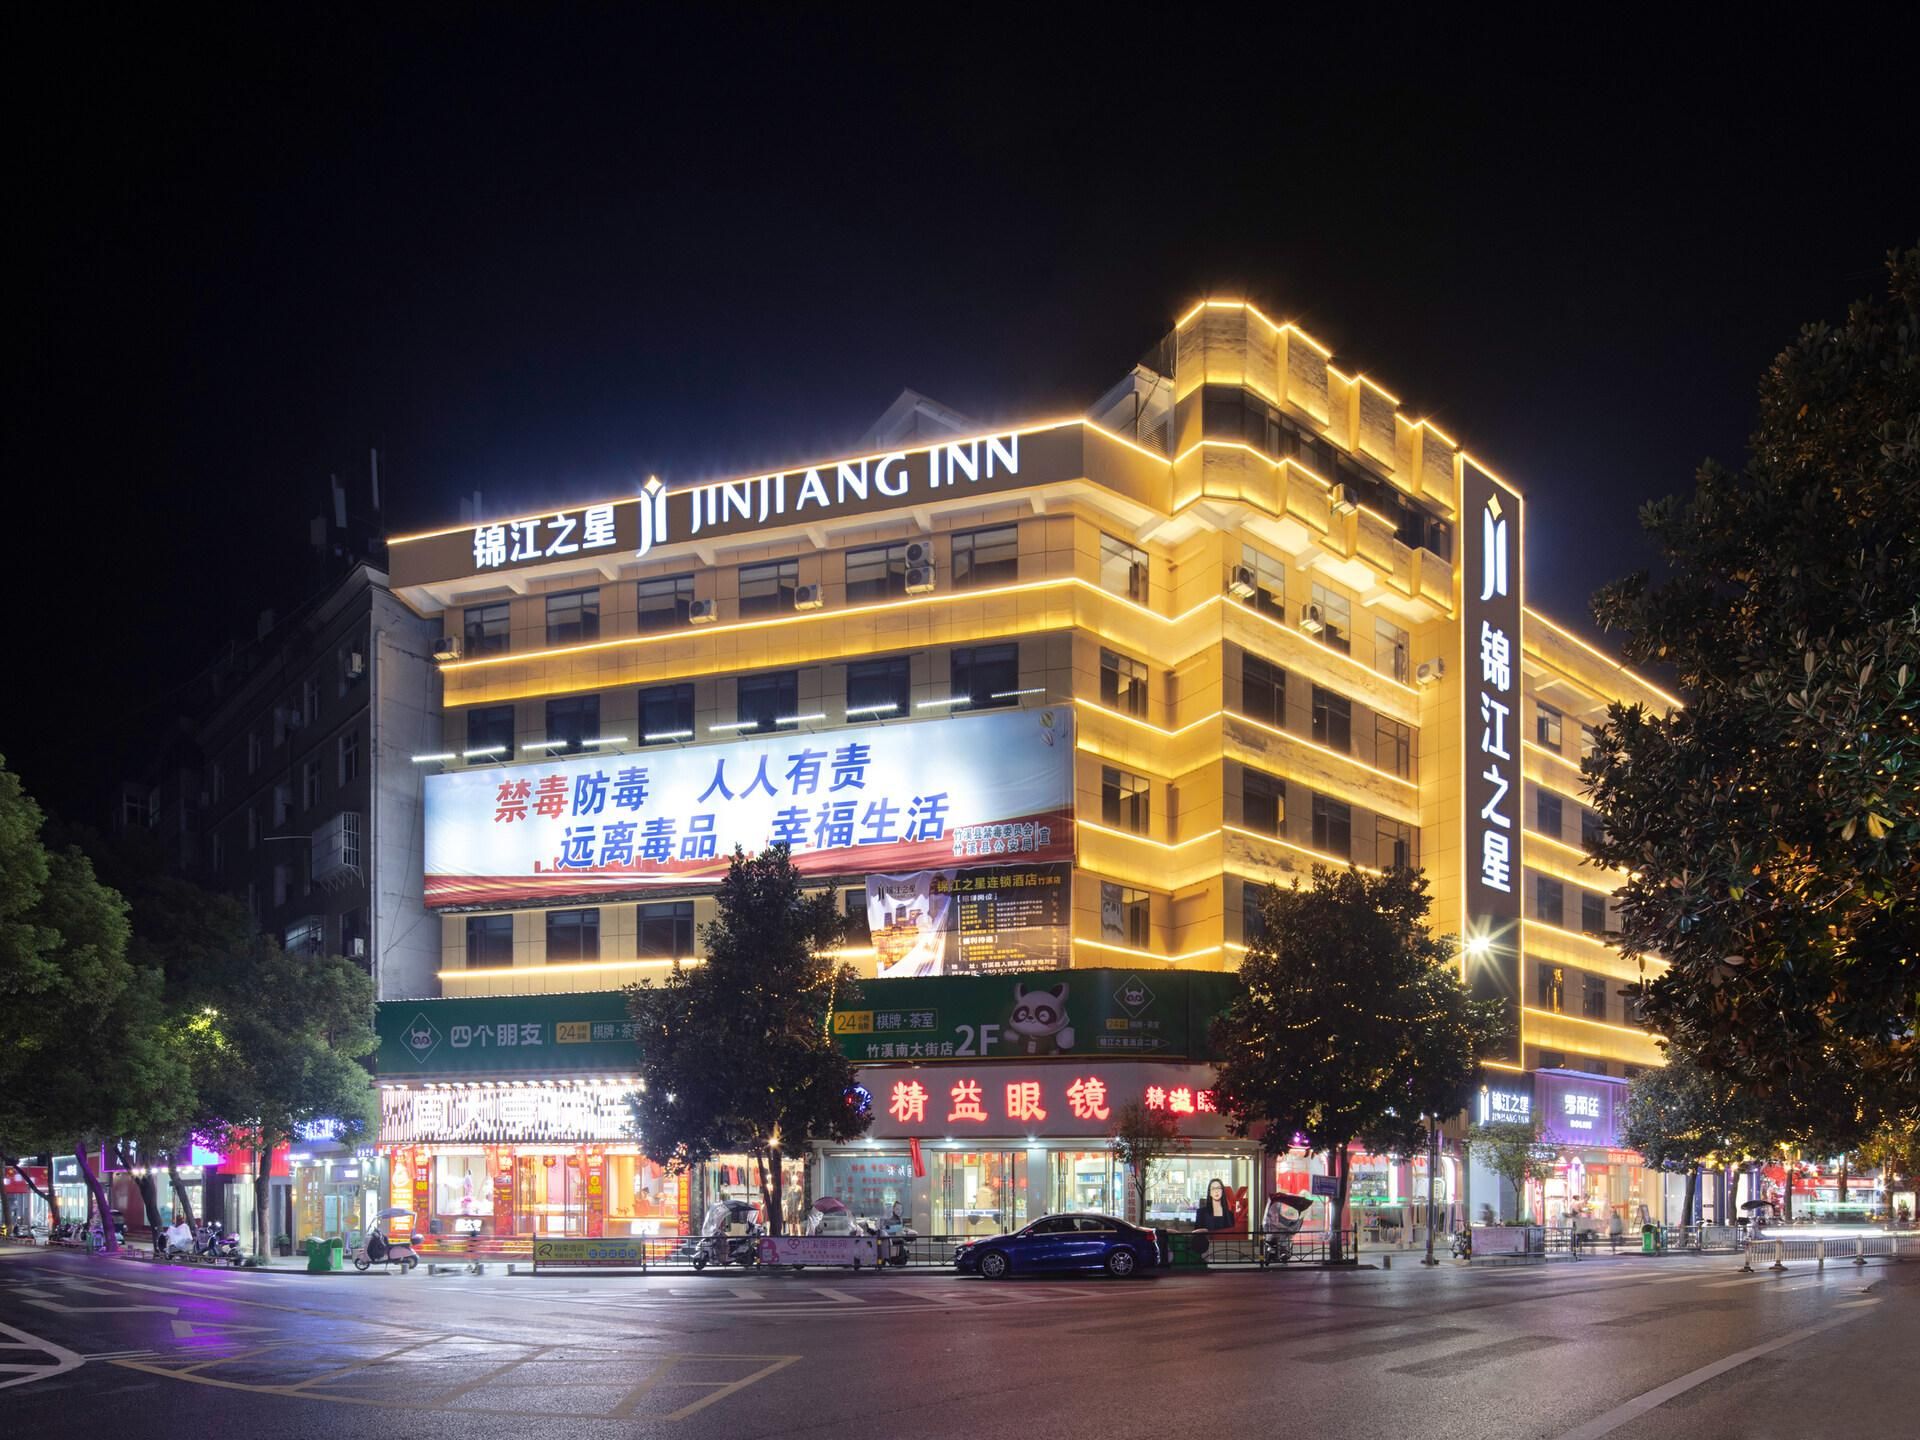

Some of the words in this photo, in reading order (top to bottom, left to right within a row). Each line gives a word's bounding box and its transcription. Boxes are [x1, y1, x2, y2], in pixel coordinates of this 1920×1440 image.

[691, 453, 909, 535] JINJIANG
[927, 432, 1021, 488] INN
[472, 505, 617, 569] 锦江之星
[1480, 619, 1511, 893] 锦江之星
[494, 766, 650, 824] 禁毒防毒
[696, 743, 872, 805] 人人有责
[557, 815, 717, 870] 远离毒品
[769, 791, 950, 849] 幸福生活
[953, 822, 1034, 841] 竹溪县禁毒委员会
[1039, 827, 1051, 846] 宣
[953, 837, 1034, 857] 竹溪县公安局
[936, 873, 1037, 894] 锦江之星连锁酒店
[450, 1022, 543, 1048] 四个朋友
[559, 1025, 576, 1041] 24
[838, 1014, 857, 1031] 24
[867, 1041, 954, 1059] 竹溪南大街店
[955, 1024, 1001, 1057] 2F
[889, 1077, 1111, 1122] 精益眼镜
[1491, 1091, 1530, 1114] 锦江之星
